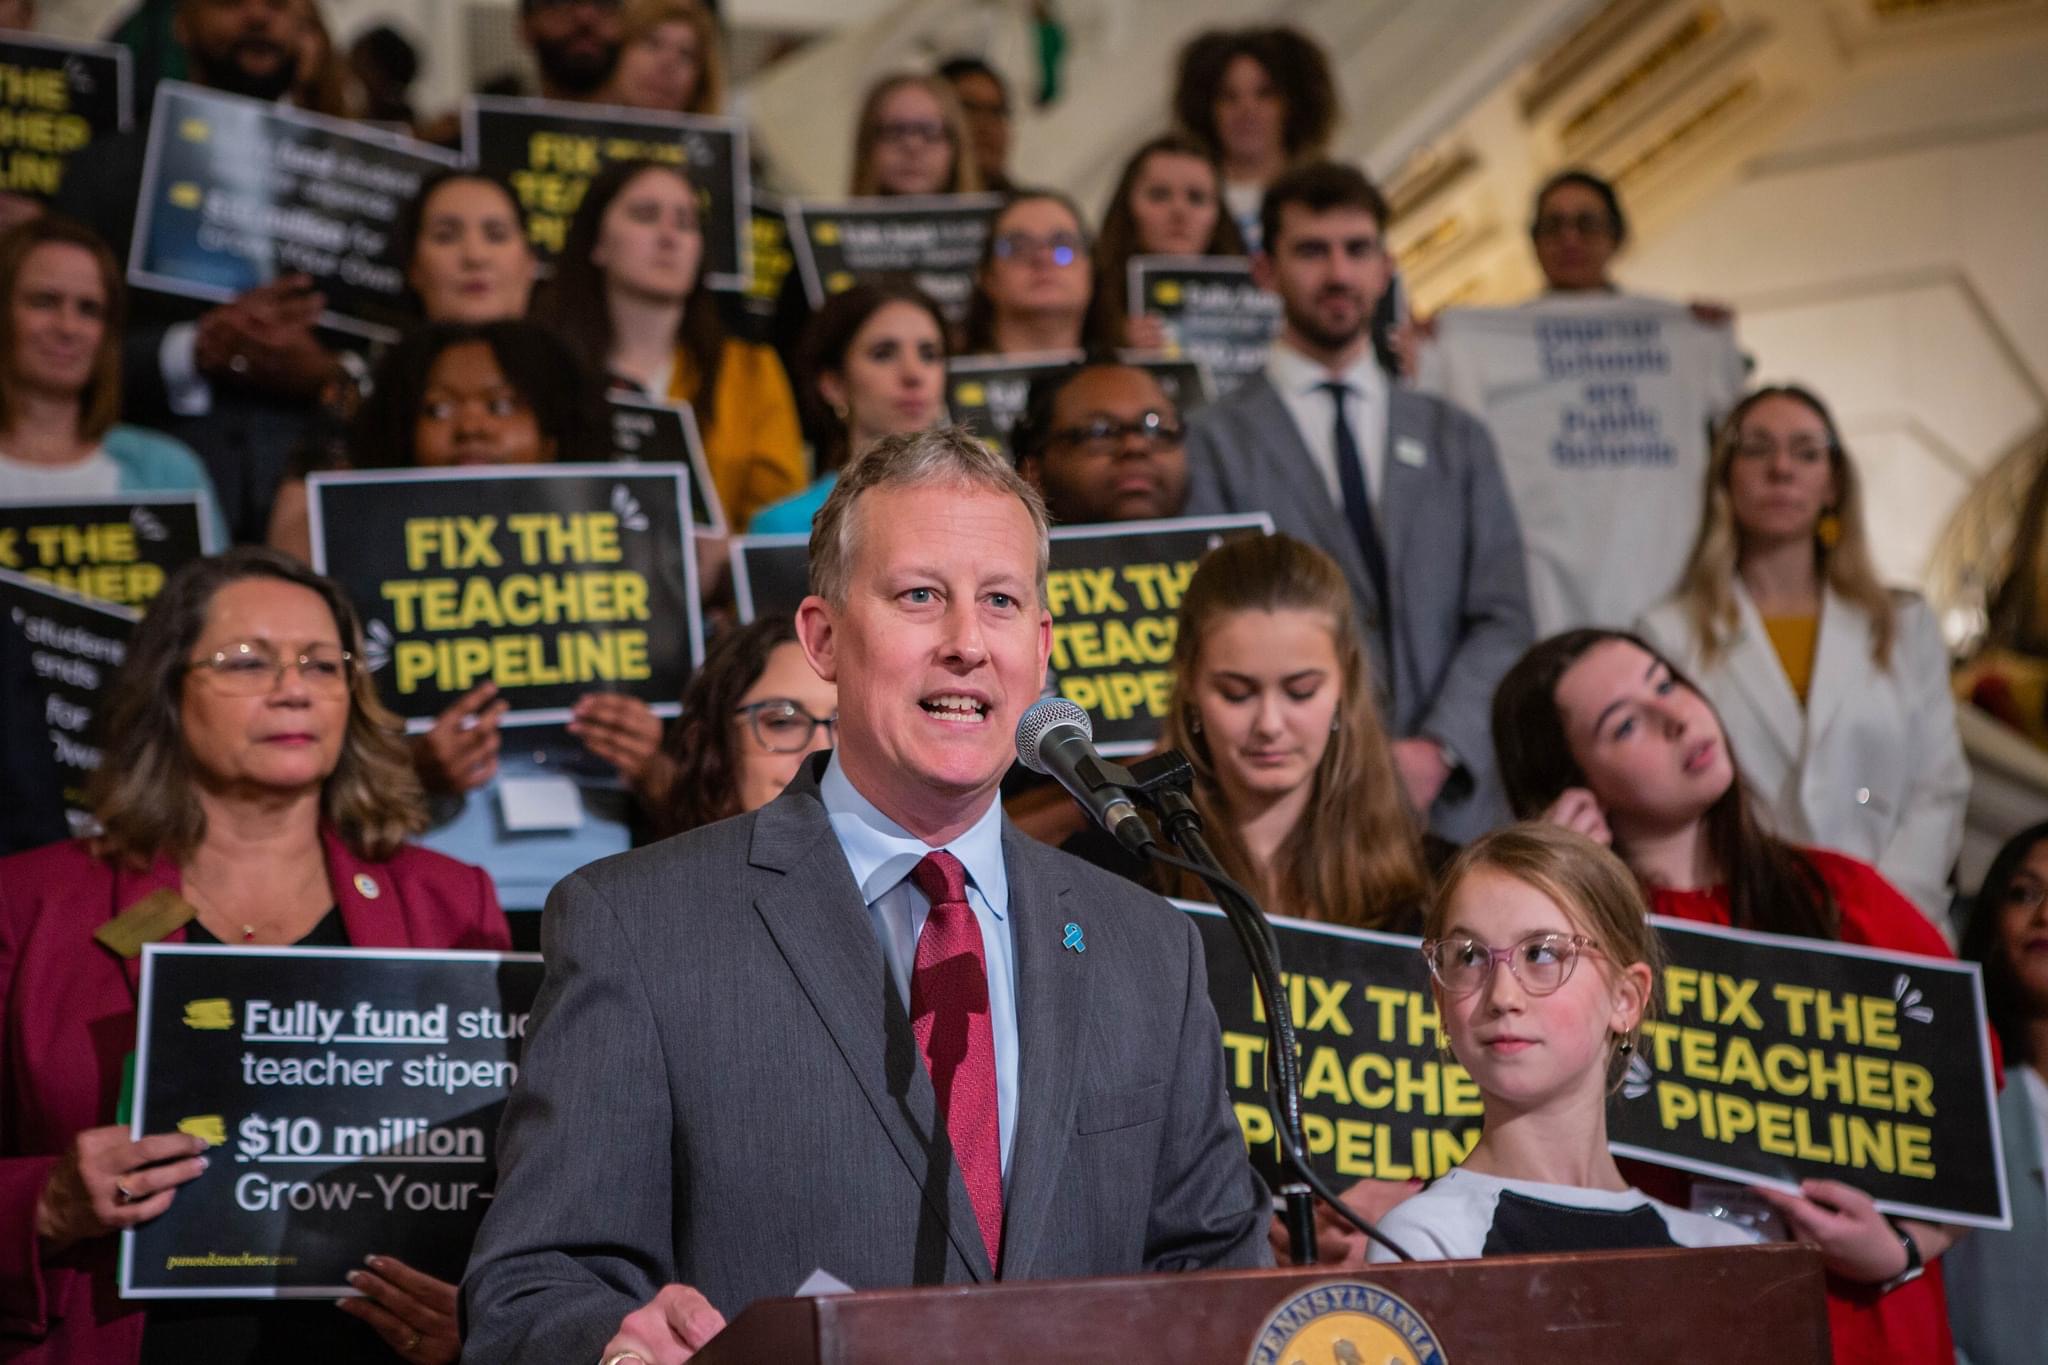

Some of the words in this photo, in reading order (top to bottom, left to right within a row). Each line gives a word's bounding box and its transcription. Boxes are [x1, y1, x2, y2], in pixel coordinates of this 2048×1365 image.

[26, 522, 138, 565] THE
[405, 514, 503, 571] FIX
[507, 511, 622, 565] THE
[380, 571, 651, 633] TEACHER
[1047, 567, 1128, 617] FIX
[395, 629, 652, 694] PIPELINE
[244, 1000, 344, 1044] Fully
[352, 1001, 449, 1038] fund
[1664, 966, 1764, 1030] FIX
[1773, 983, 1901, 1050] THE
[240, 1051, 393, 1086] teacher
[402, 1053, 518, 1095] stipen
[1223, 1031, 1485, 1117] TACHE
[1641, 1020, 1937, 1118] TEACHER
[238, 1113, 321, 1158] $10
[333, 1117, 485, 1156] million
[1233, 1102, 1483, 1180] PPELIN
[1657, 1081, 1936, 1180] PIPELINE
[235, 1172, 496, 1211] Grow-Your-
[1253, 1285, 1436, 1365] PENNSYLVANIA
